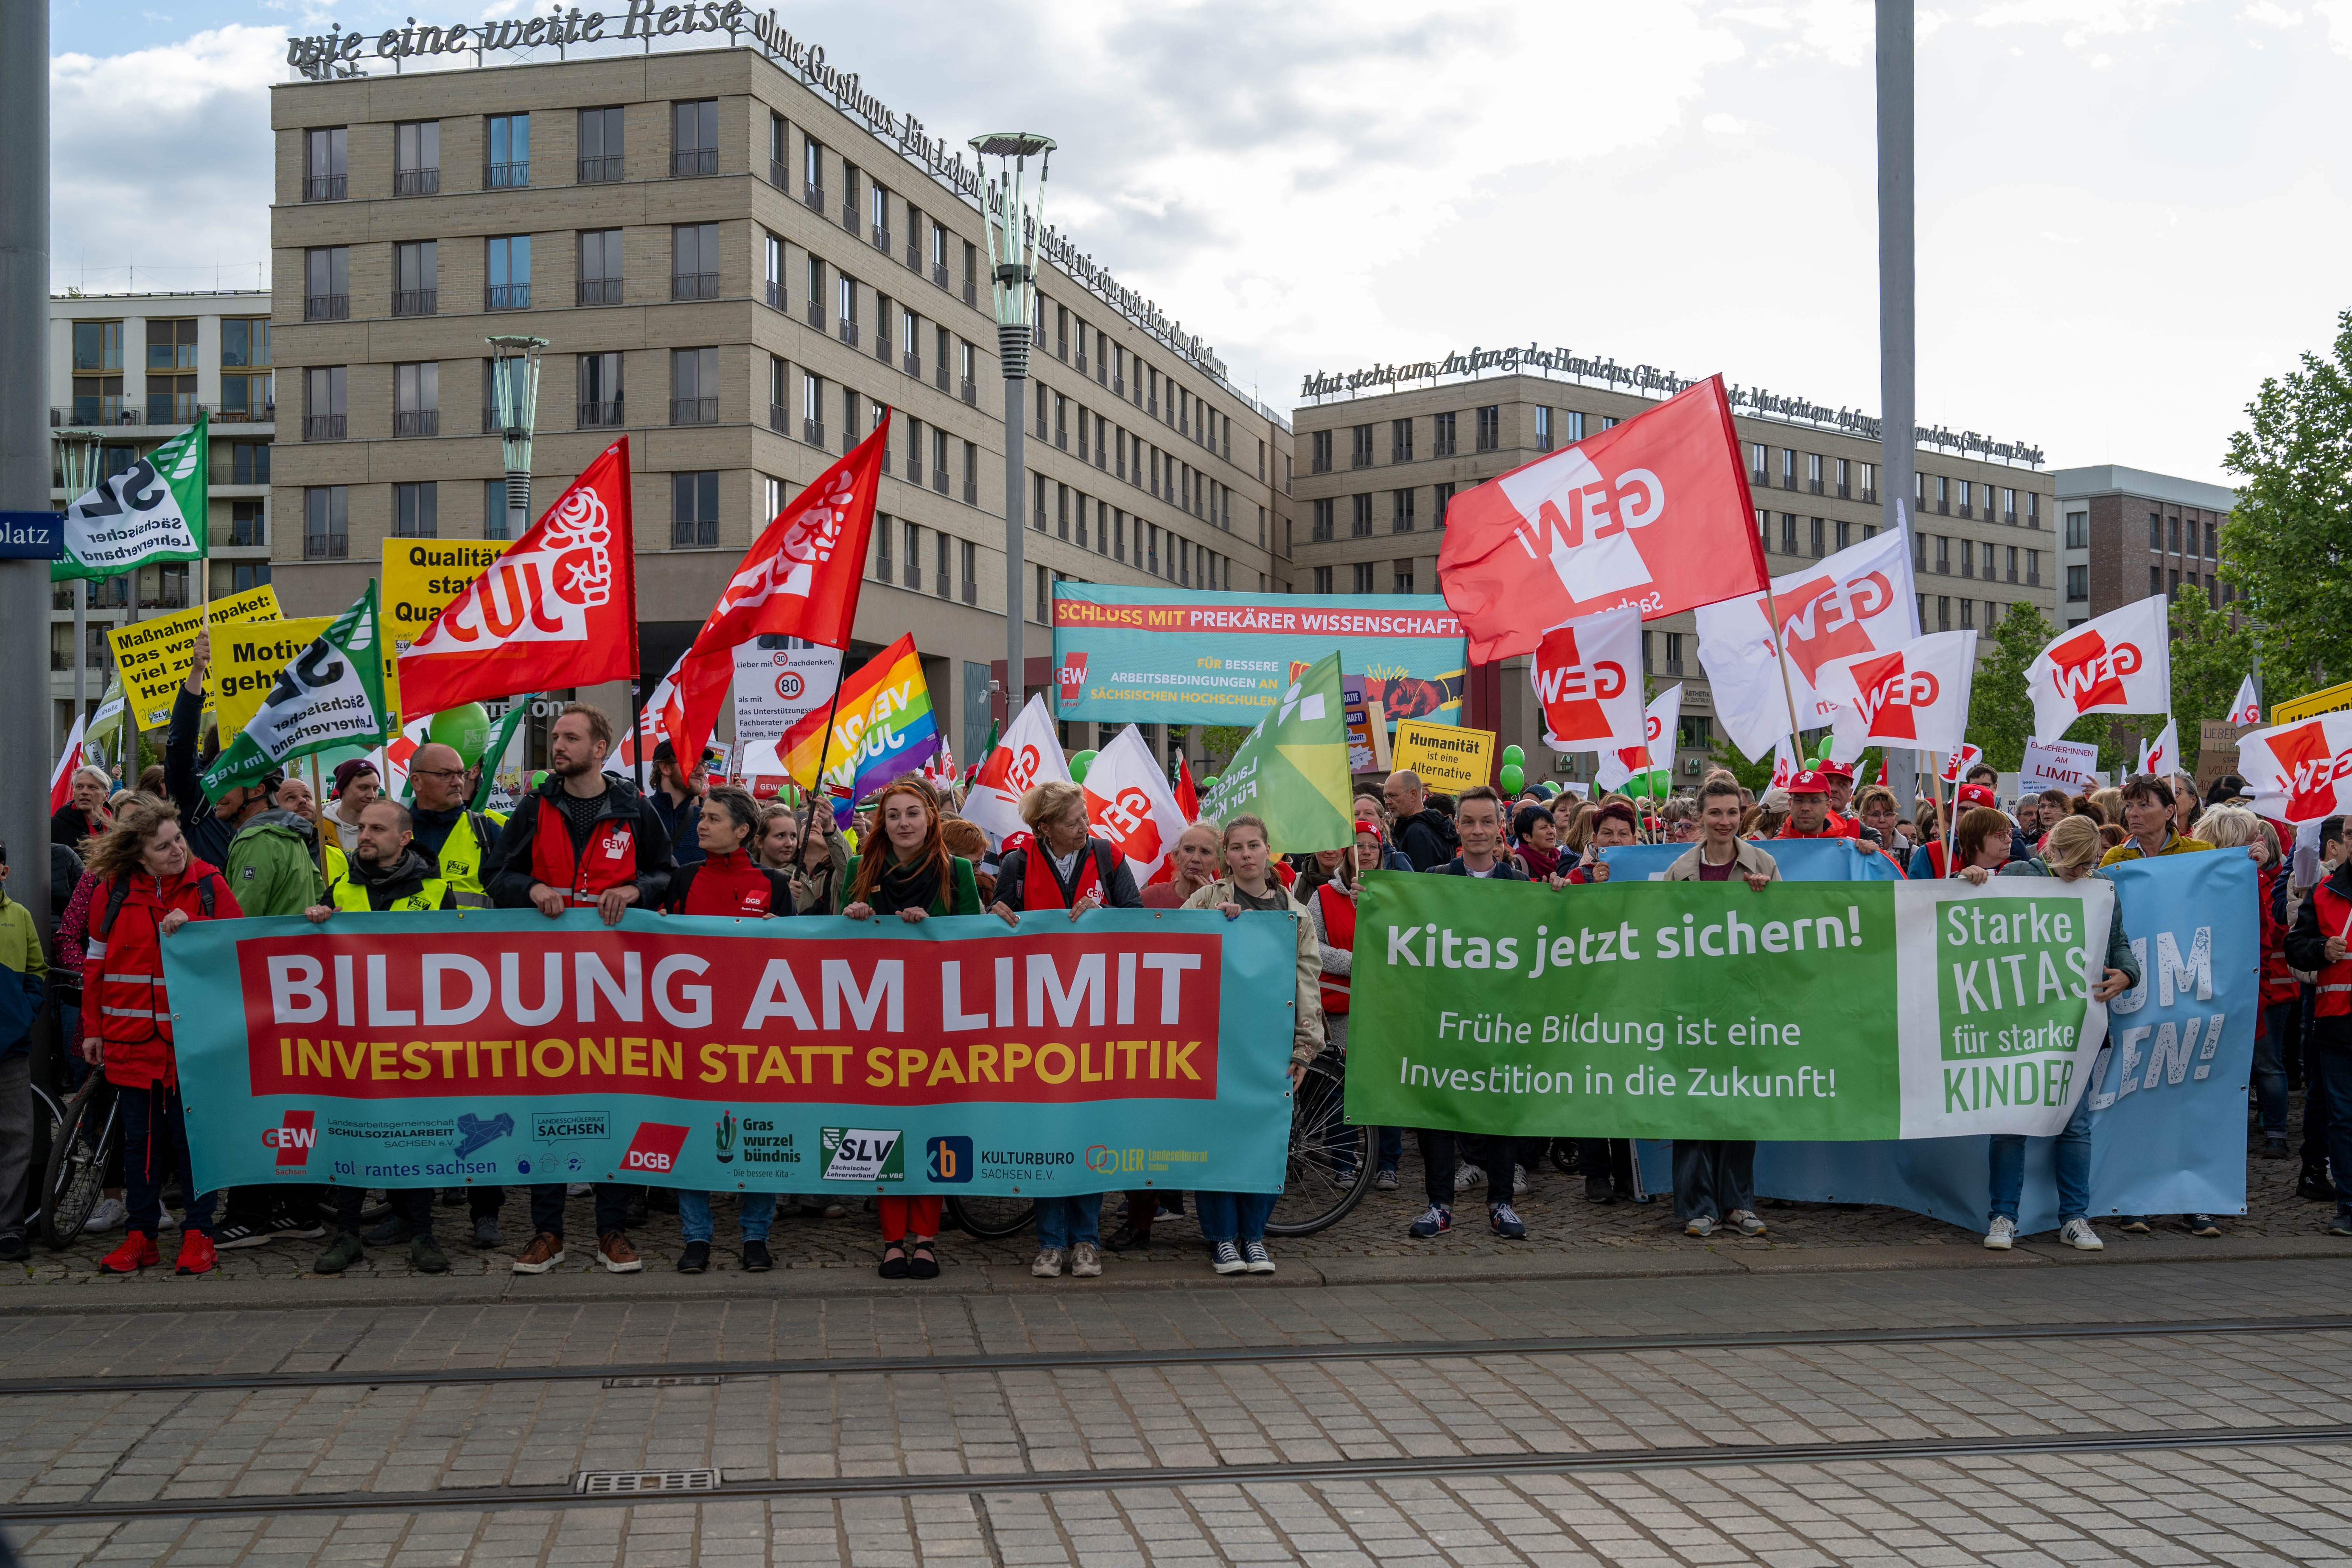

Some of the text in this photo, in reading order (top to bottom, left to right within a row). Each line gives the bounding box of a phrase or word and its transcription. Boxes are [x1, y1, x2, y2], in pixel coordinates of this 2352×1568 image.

[287, 0, 744, 67] wie eine weite Reise
[755, 8, 806, 68] ohne
[903, 113, 934, 164] Ein
[938, 138, 983, 202] Leben
[1062, 234, 1078, 269] ist
[1077, 254, 1099, 284] wie
[1099, 266, 1121, 300] eine
[1121, 290, 1148, 322] weite
[1148, 300, 1171, 339] Reise
[1171, 321, 1192, 352] ohne
[1300, 342, 1679, 397] Mut steht am Anfang des Handelns, Glück
[1751, 387, 1780, 412] Mut
[1779, 397, 1811, 419] steht
[1811, 405, 1834, 423] am
[1915, 420, 2046, 464] andelns, Glück am Ende.
[429, 576, 473, 594] stat
[1059, 603, 1464, 634] SCHLUSS MIT PREKÄRER WISSENSCHAFT!
[120, 648, 160, 668] Das
[1198, 656, 1279, 672] FÜR BESSERE
[130, 662, 166, 684] viel
[1054, 667, 1089, 684] GEW
[1110, 672, 1278, 689] ARBEITSBEDINGUNGEN AN
[781, 679, 798, 692] 80
[1685, 689, 1710, 697] ÄSTHETIK
[1090, 686, 1277, 706] SÄCHSISCHEN HOCHSCHULEN
[154, 710, 168, 719] SLV
[2204, 728, 2237, 740] LIEBER
[1409, 732, 1480, 754] Humanität
[1427, 751, 1458, 763] ist eine
[1560, 754, 1574, 763] AOK
[1689, 758, 1701, 766] AOK
[1410, 761, 1471, 780] Alternative
[2035, 764, 2082, 784] LIMIT
[602, 837, 630, 852] GEW
[452, 863, 467, 871] SLV
[413, 899, 428, 908] SLV
[1948, 902, 2072, 947] Starke
[1387, 905, 1863, 980] Kitas jetzt sichern!
[1953, 947, 2088, 1015] KITAS
[267, 951, 1201, 1033] BILDUNG AM LIMIT
[1438, 1011, 1801, 1052] Frühe Bildung ist eine
[1952, 1019, 2074, 1055] für starke
[280, 1037, 1201, 1087] INVESTITIONEN STATT SPARPOLITIK
[1400, 1057, 1836, 1099] Investition in die Zukunft!
[1944, 1059, 2074, 1114] KINDER
[328, 1118, 455, 1129] Landesarbeitsgemeinschaft
[537, 1116, 604, 1125] LANDESSCHÜLERRAT
[743, 1118, 774, 1131] Gras
[262, 1128, 318, 1148] GEW
[328, 1127, 455, 1138] SCHULSOZIALARBEIT
[538, 1123, 605, 1137] SACHSEN
[384, 1140, 436, 1148] SACHSEN
[744, 1134, 793, 1146] wurzel
[744, 1149, 801, 1163] bündnis
[839, 1138, 894, 1162] SLV
[981, 1150, 1075, 1165] KULTURBÜRO
[1148, 1149, 1208, 1162] Landeselternrat
[425, 1159, 496, 1175] sachsen
[629, 1151, 670, 1170] DGB
[1123, 1148, 1144, 1172] LER
[275, 1168, 307, 1176] Sachsen
[733, 1169, 789, 1178] Die bessere Kita
[981, 1168, 1055, 1180] SACHSEN E.V.
